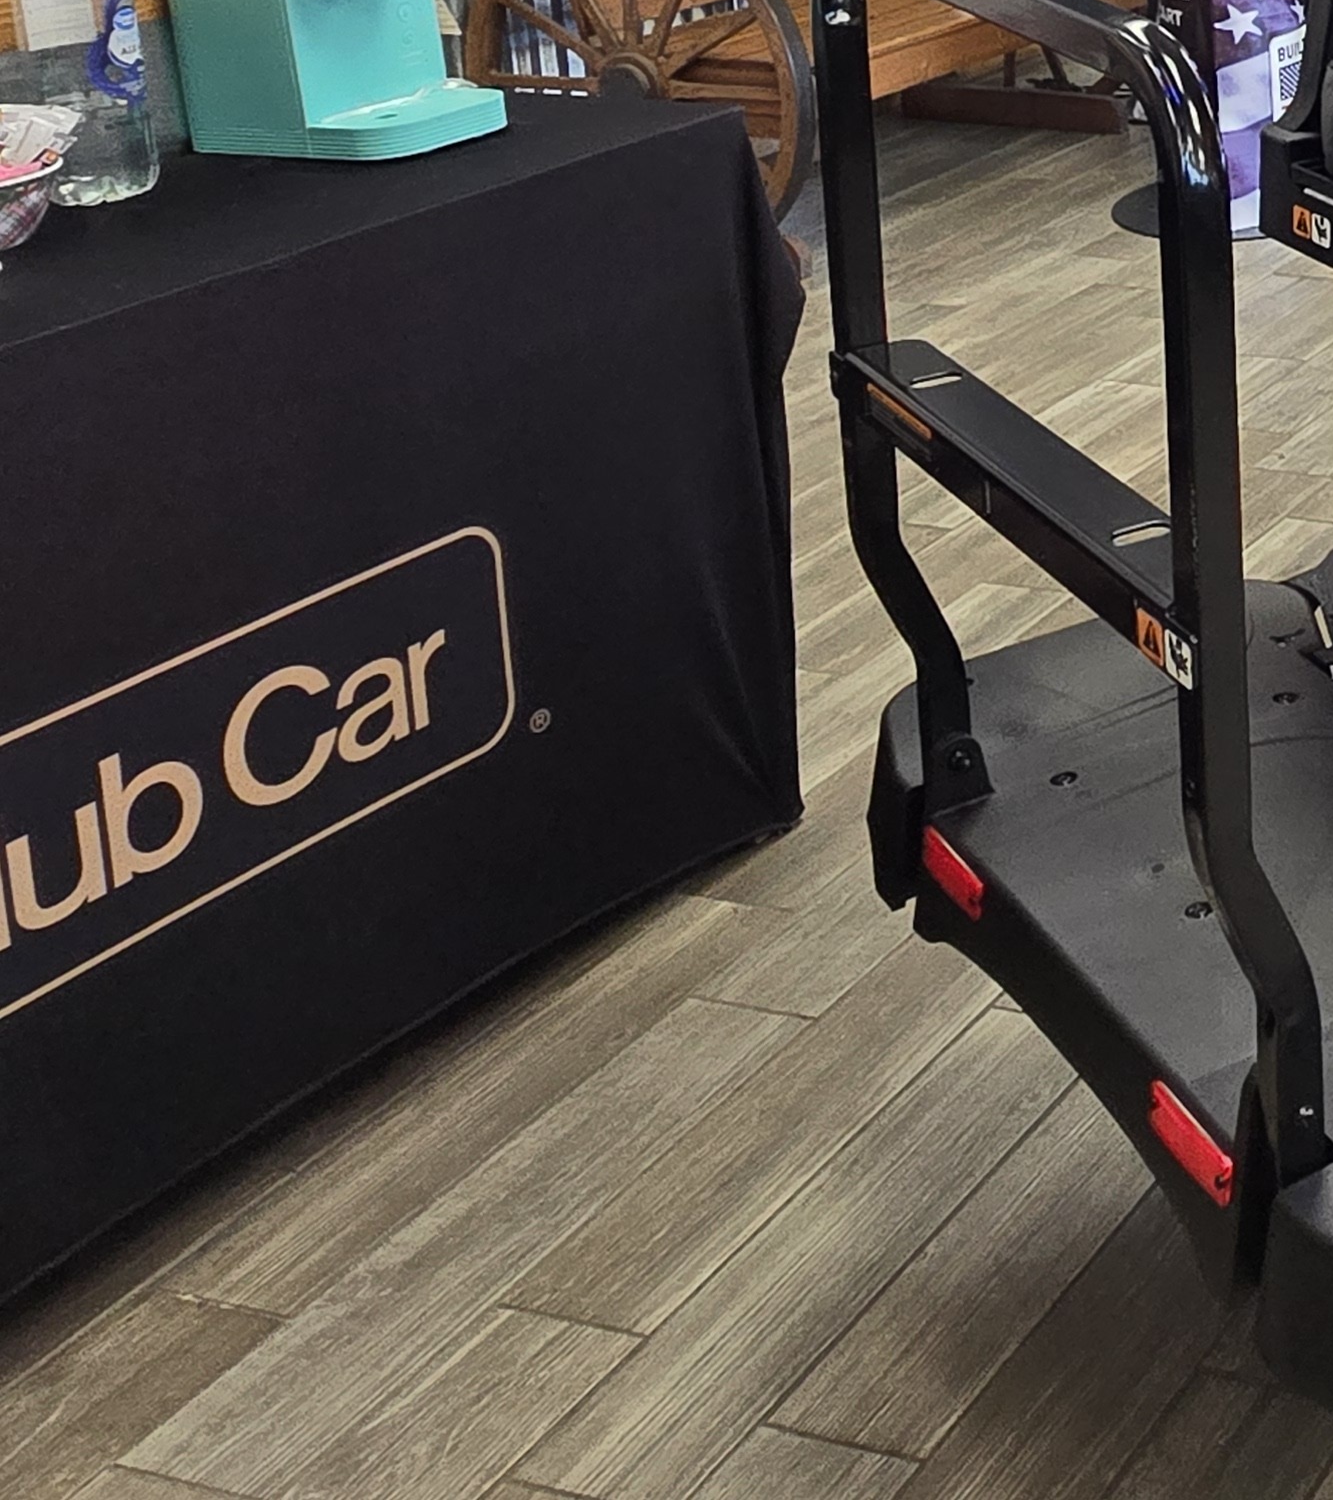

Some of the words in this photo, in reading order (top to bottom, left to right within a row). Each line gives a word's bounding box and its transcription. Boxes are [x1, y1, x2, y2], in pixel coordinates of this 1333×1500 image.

[1160, 5, 1184, 27] ART
[0, 753, 204, 952] ub
[223, 628, 446, 807] Car
